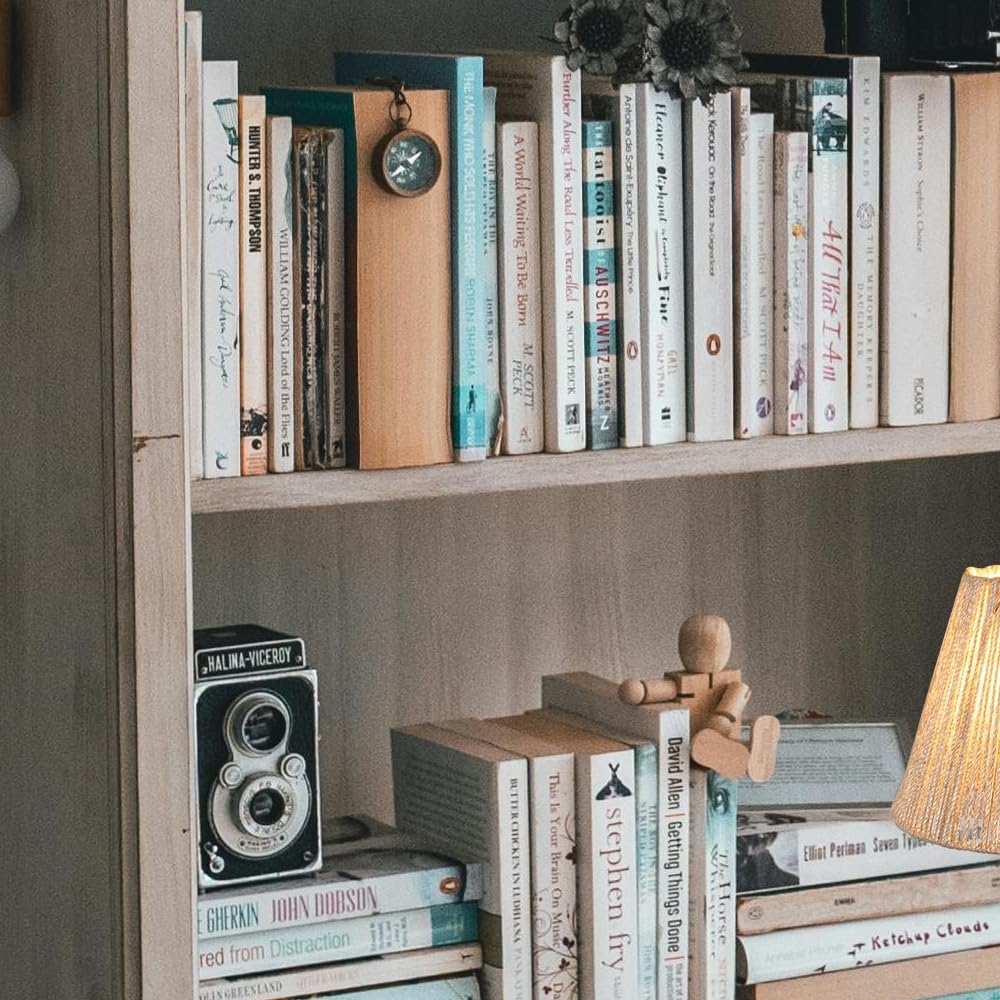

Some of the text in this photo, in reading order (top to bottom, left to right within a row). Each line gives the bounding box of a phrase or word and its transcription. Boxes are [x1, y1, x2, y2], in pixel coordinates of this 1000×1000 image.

[561, 73, 576, 117] Further
[625, 96, 633, 136] Antoine
[561, 121, 577, 154] Along
[708, 120, 718, 162] Kerouac
[248, 126, 262, 253] HUNTER S. THOMPSON
[563, 159, 577, 181] The
[564, 186, 577, 216] Road
[593, 151, 610, 243] tattooist
[709, 195, 718, 218] Road
[514, 135, 531, 327] A World Waiting To Be Born
[564, 221, 574, 246] Less
[595, 266, 610, 364] AUSCHWITZ
[866, 274, 874, 330] MEMORY
[279, 228, 292, 439] WILLIAM GOLDING Lord of the Flies
[567, 326, 576, 362] SCOTT
[512, 359, 523, 396] PECK
[524, 363, 535, 410] SCOTT
[567, 365, 577, 395] PECK
[912, 377, 926, 416] PICADOR
[207, 646, 292, 673] HALINA-VICEROY
[509, 778, 522, 943] BUTTER CHICKEN IN LUDHIANA
[549, 772, 564, 949] This Is Your Brain On Music
[663, 736, 684, 954] David Allen Getting Things Done
[803, 835, 899, 862] Elliot Perlman Seven
[206, 885, 379, 934] GHERKIN JOHN DOBSON
[600, 808, 632, 972] stephen fry
[717, 880, 732, 946] Horse
[230, 944, 266, 965] from
[270, 932, 351, 959] Distraction
[871, 921, 990, 952] Ketchup Clouds
[224, 980, 284, 1000] GREENLAND
